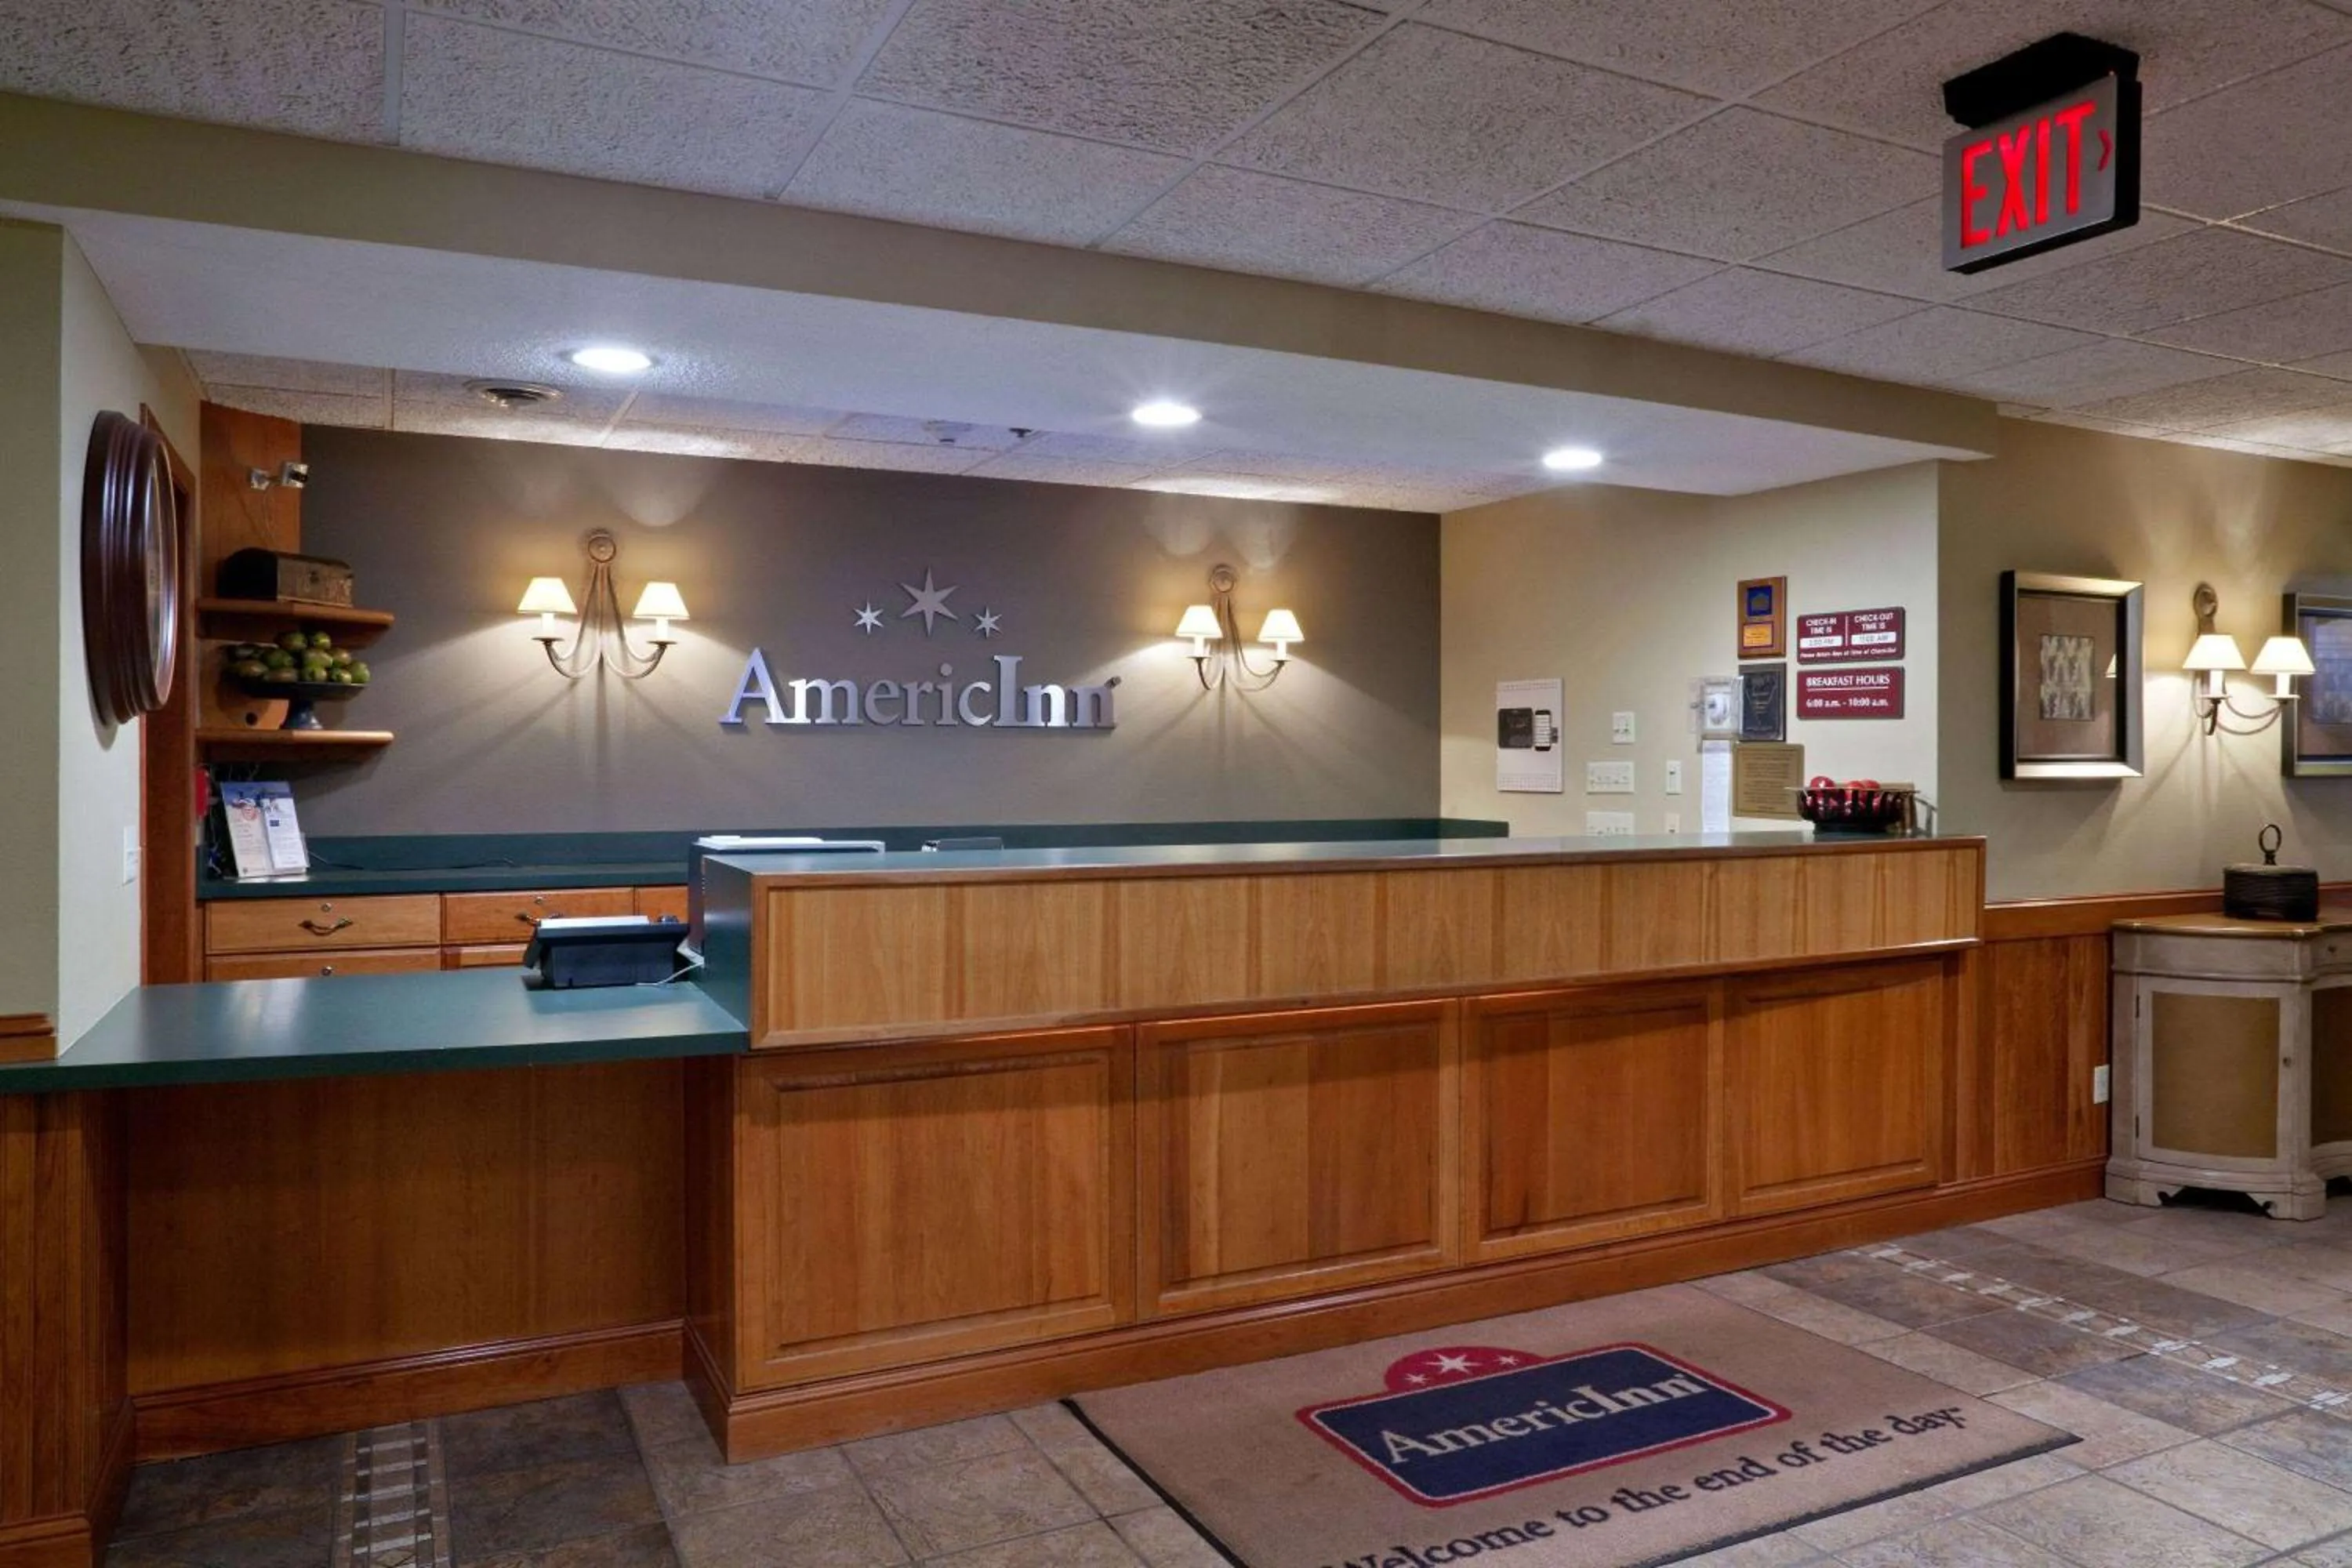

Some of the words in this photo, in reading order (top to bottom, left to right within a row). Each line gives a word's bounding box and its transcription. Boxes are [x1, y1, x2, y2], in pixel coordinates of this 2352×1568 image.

[1961, 100, 2096, 249] EXIT
[1806, 617, 1837, 626] CHECK-IN
[1854, 612, 1894, 623] CHECK-OUT
[1862, 622, 1877, 631] TIME
[1806, 675, 1853, 687] BREAKFAST
[1856, 673, 1890, 685] HOURS
[717, 647, 1116, 728] AmericInn
[1806, 699, 1823, 708] 6:00
[1849, 697, 1870, 707] 10:00
[1381, 1373, 1708, 1464] AmericInn
[1555, 1505, 1610, 1529] to
[1610, 1486, 1691, 1514] the
[1694, 1457, 1778, 1490] end
[1777, 1441, 1828, 1468] of
[1820, 1432, 1894, 1456] the
